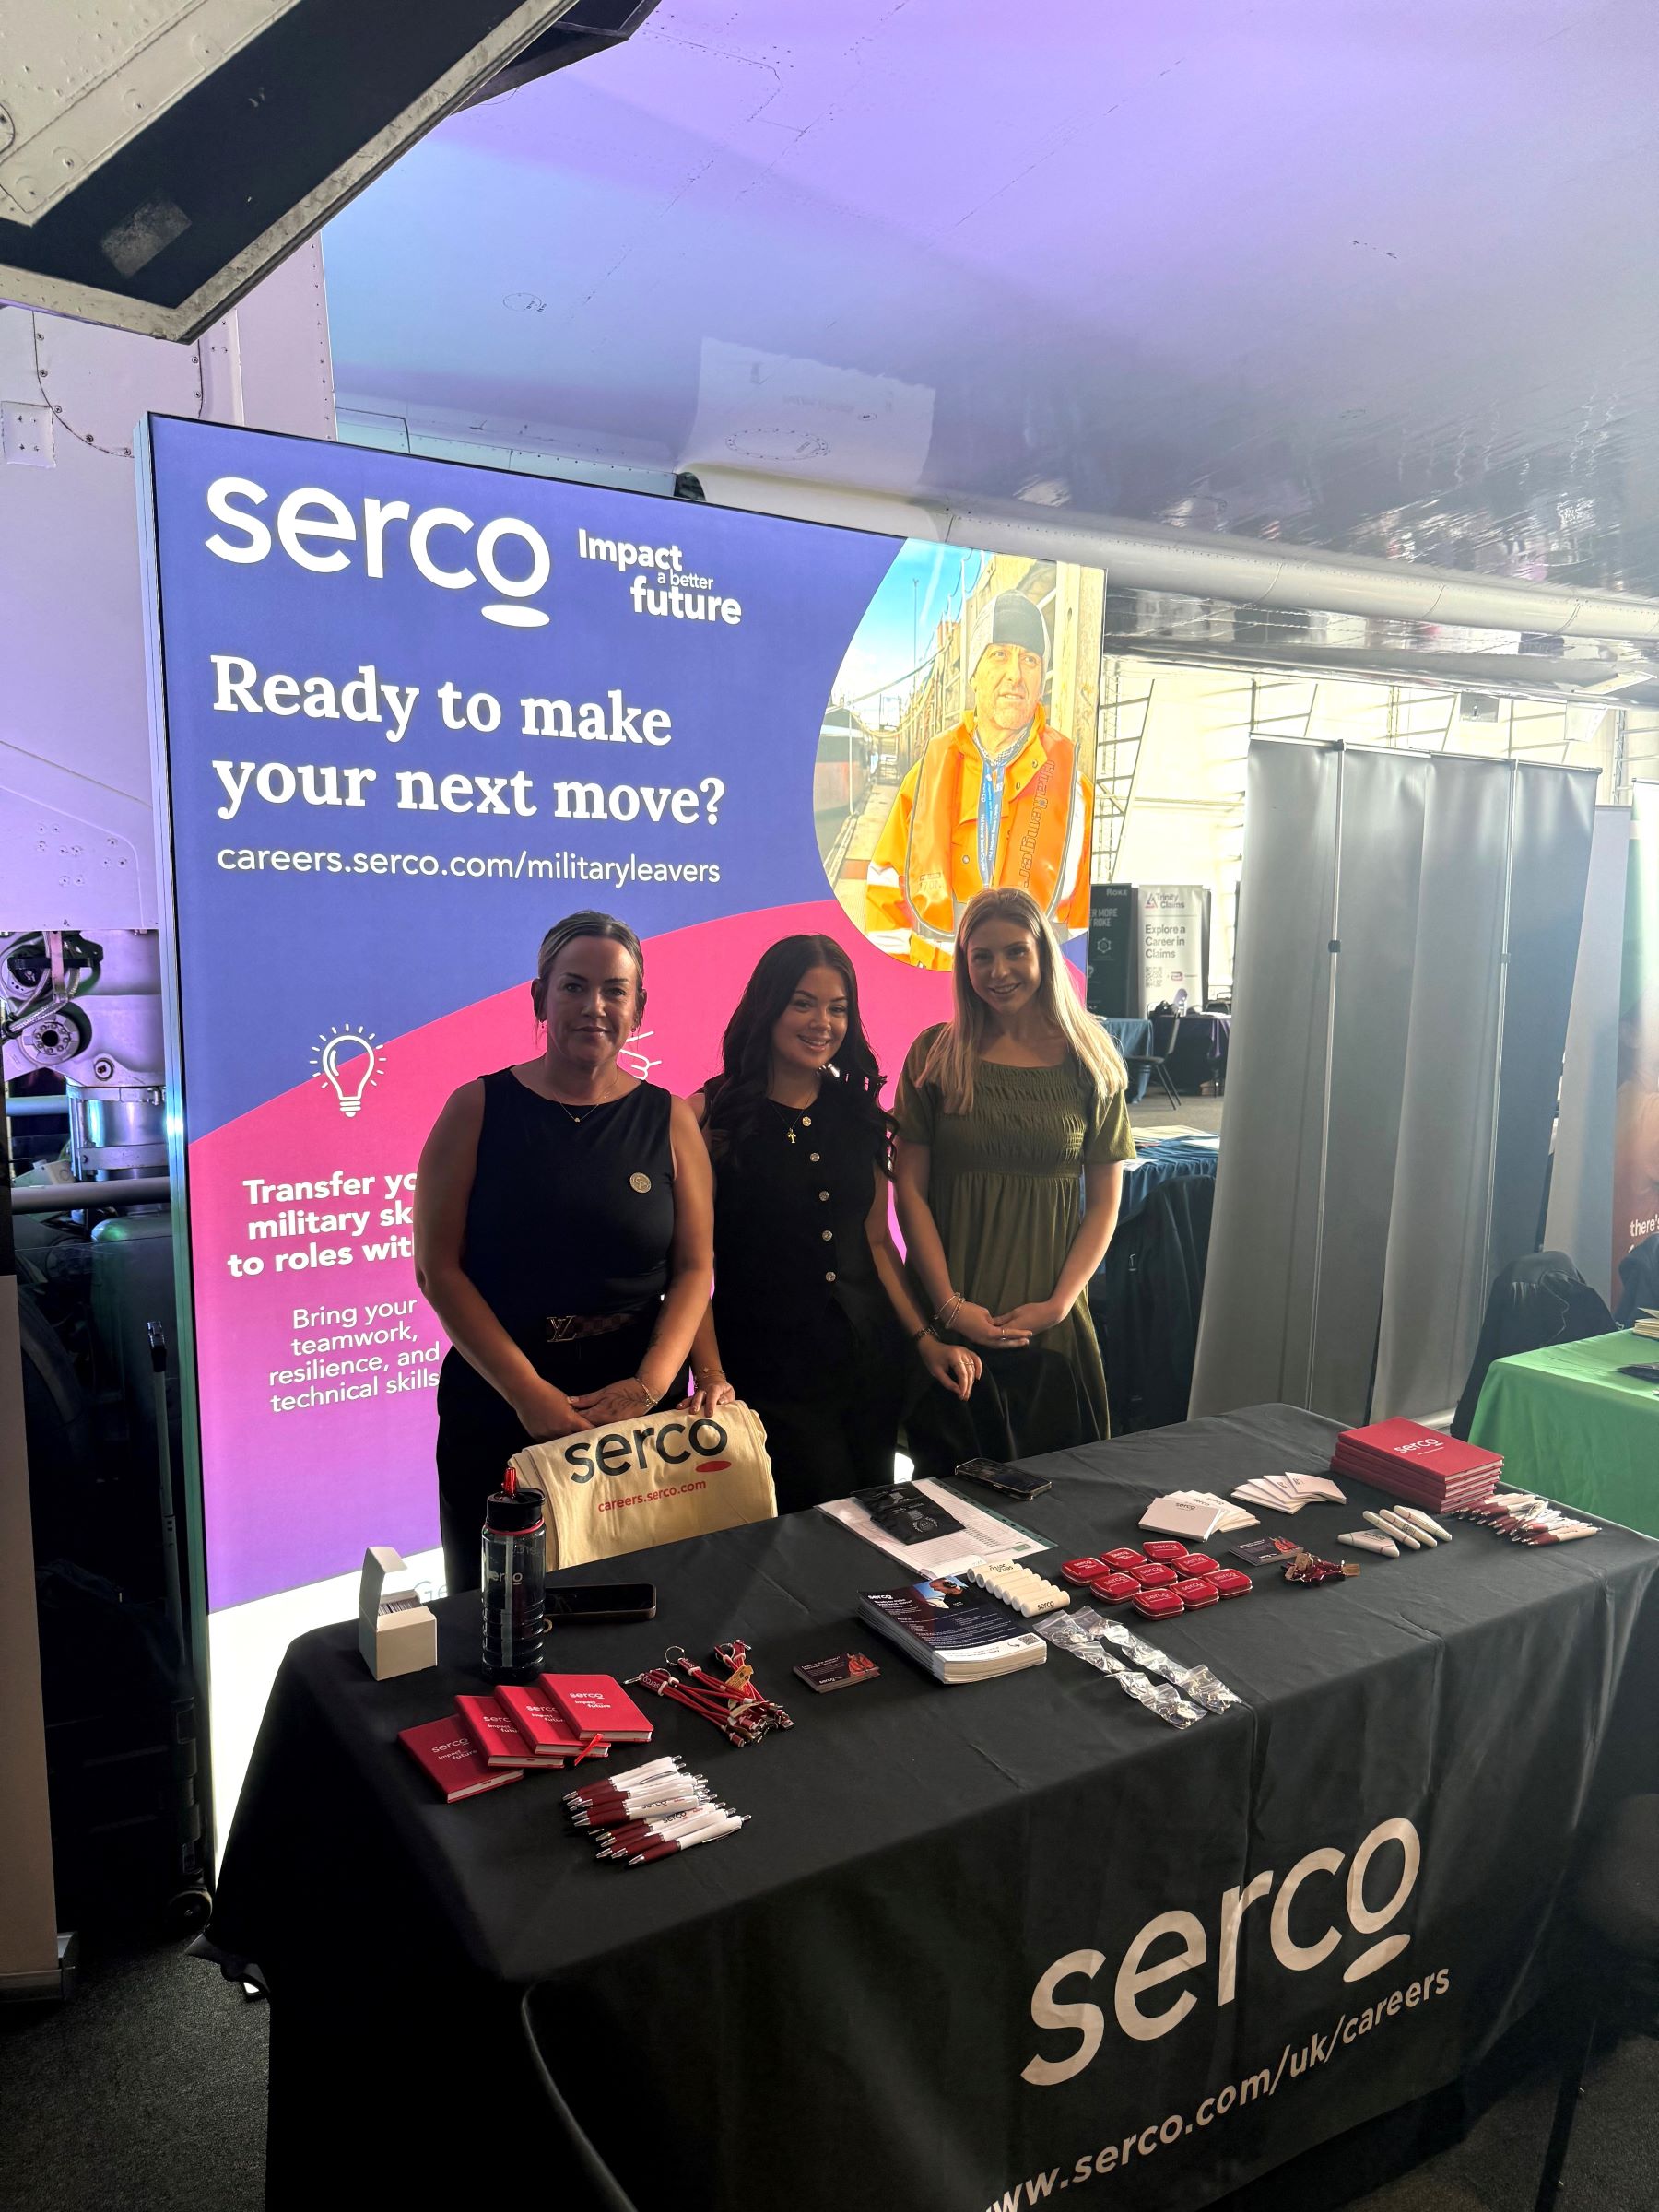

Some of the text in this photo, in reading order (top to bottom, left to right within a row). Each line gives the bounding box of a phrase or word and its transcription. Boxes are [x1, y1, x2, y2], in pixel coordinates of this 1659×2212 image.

[205, 476, 550, 627] serco
[578, 528, 683, 571] Impact
[657, 569, 713, 590] a better
[629, 575, 742, 625] future
[210, 654, 672, 746] Ready to make
[212, 759, 725, 825] your next move?
[218, 847, 721, 888] careers.serco.com/militaryleavers
[1156, 892, 1179, 901] Trinity
[1160, 900, 1185, 909] Claims
[1145, 924, 1178, 936] Explore
[1145, 936, 1185, 947] Career in
[1145, 948, 1176, 958] Claims
[242, 1171, 375, 1205] Transfer
[248, 1208, 370, 1240] military
[227, 1232, 415, 1277] to roles wit
[292, 1299, 418, 1329] Bring your
[290, 1322, 418, 1356] teamwork,
[269, 1342, 440, 1387] resilience, and
[270, 1368, 441, 1413] technical skills
[564, 1418, 732, 1484] serco
[1394, 1438, 1444, 1453] serco
[597, 1478, 707, 1512] careers.serco.com
[1037, 1600, 1054, 1611] serco
[431, 1737, 470, 1753] serco
[1020, 1817, 1421, 2086] serco
[986, 1965, 1452, 2212] ww.serco.com/uk/careers
